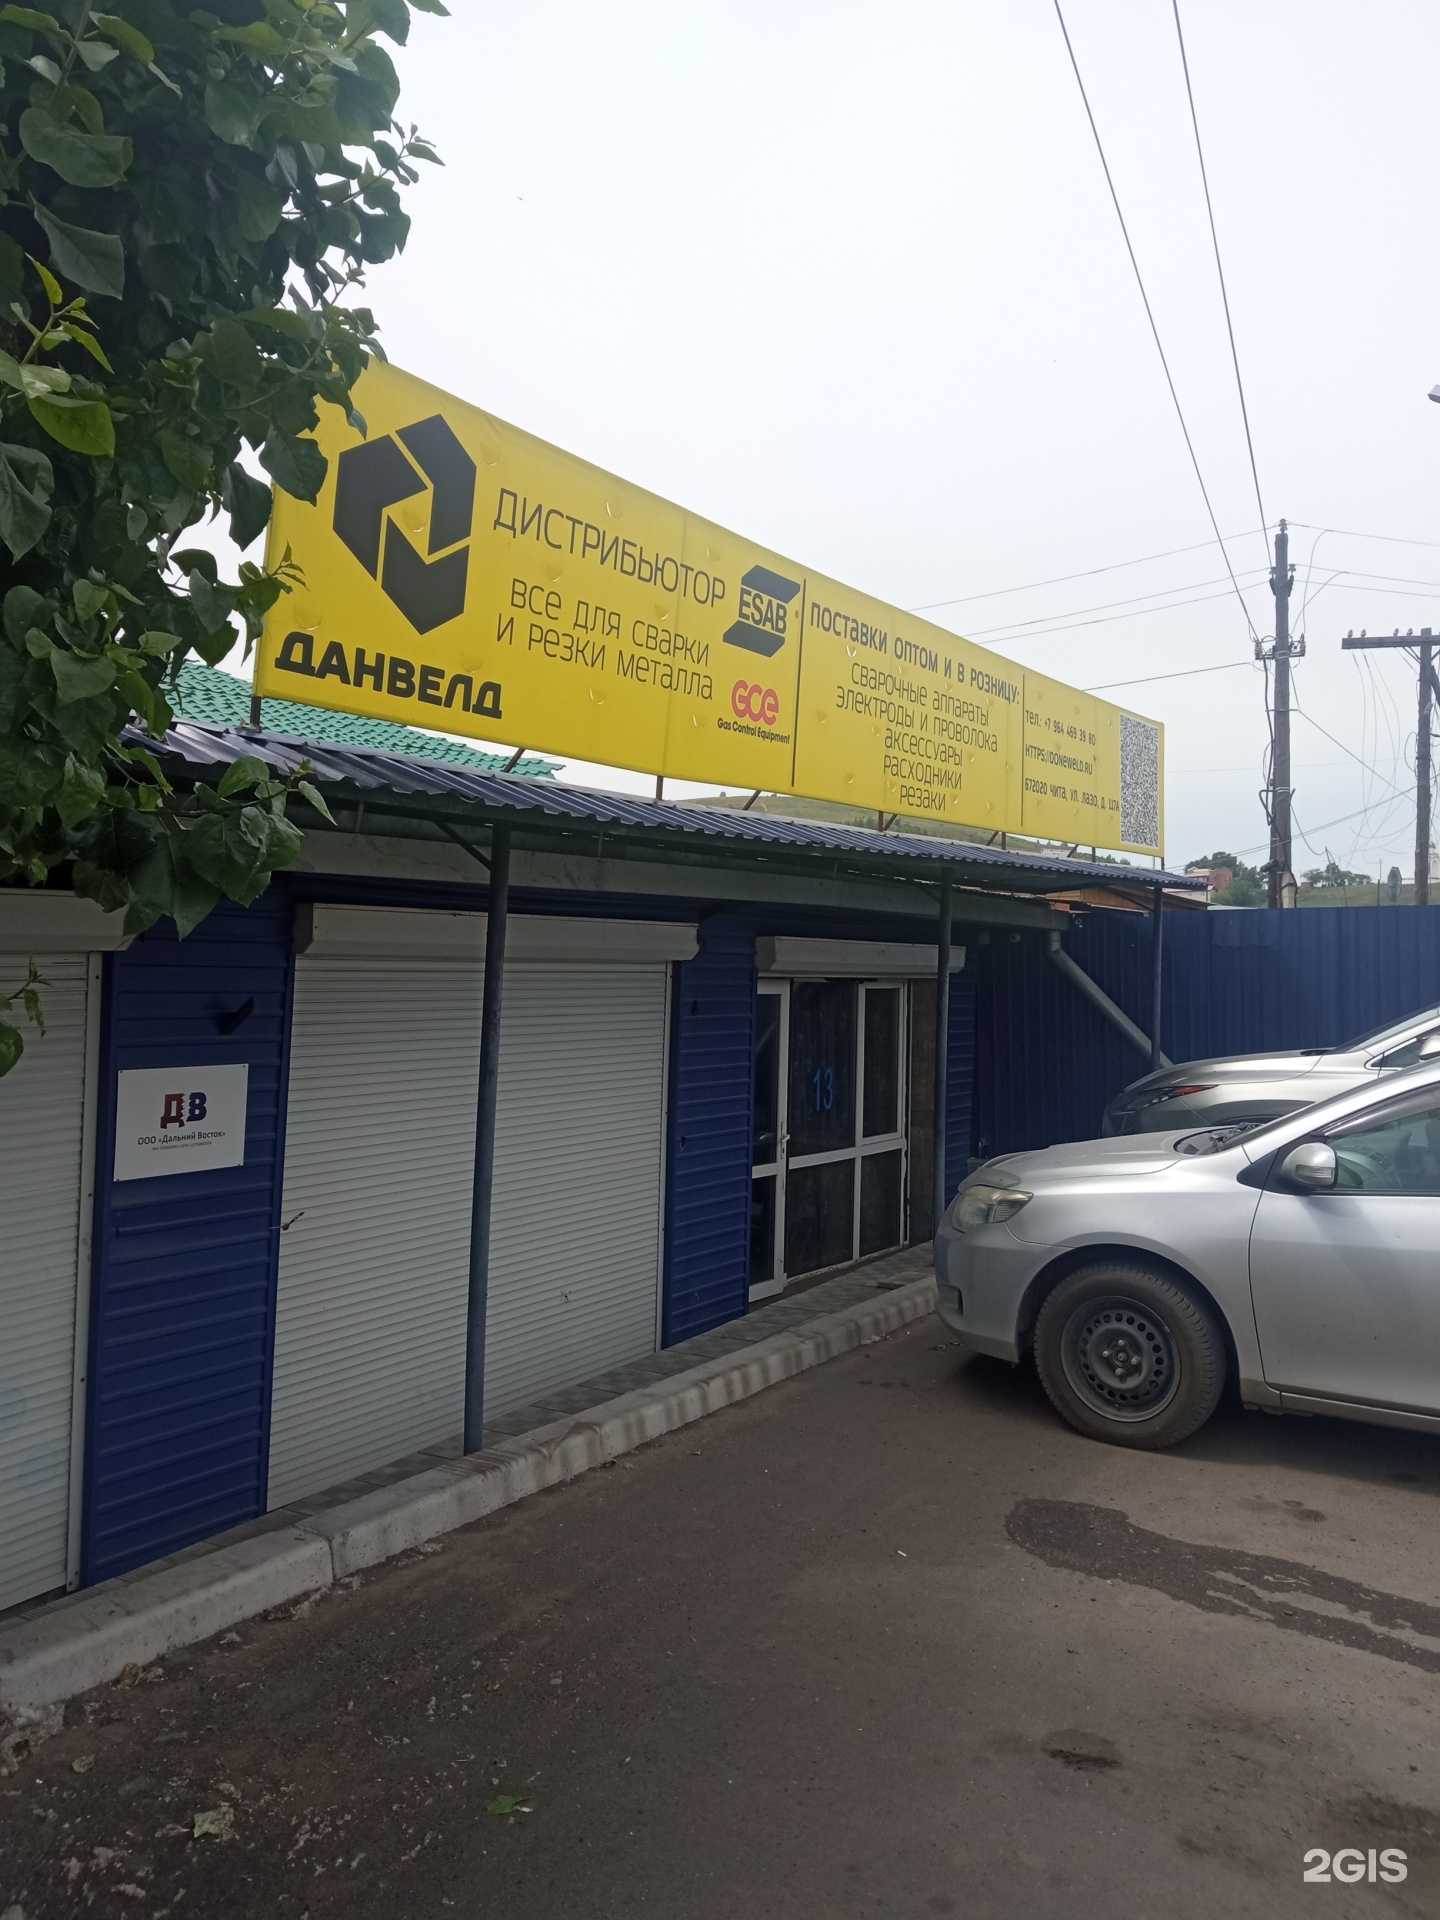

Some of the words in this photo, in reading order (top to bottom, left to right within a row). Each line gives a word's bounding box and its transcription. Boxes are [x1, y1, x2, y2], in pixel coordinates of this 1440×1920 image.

[493, 487, 725, 608] ДИСТРИБЬЮТОР
[738, 589, 788, 634] ESAB
[274, 631, 502, 719] ДАНВЕЛД
[717, 717, 732, 730] Gas
[732, 721, 757, 737] Control
[757, 727, 790, 745] Equipment
[160, 1091, 208, 1129] ДВ
[813, 1066, 833, 1113] 13
[137, 1136, 157, 1145] ООО
